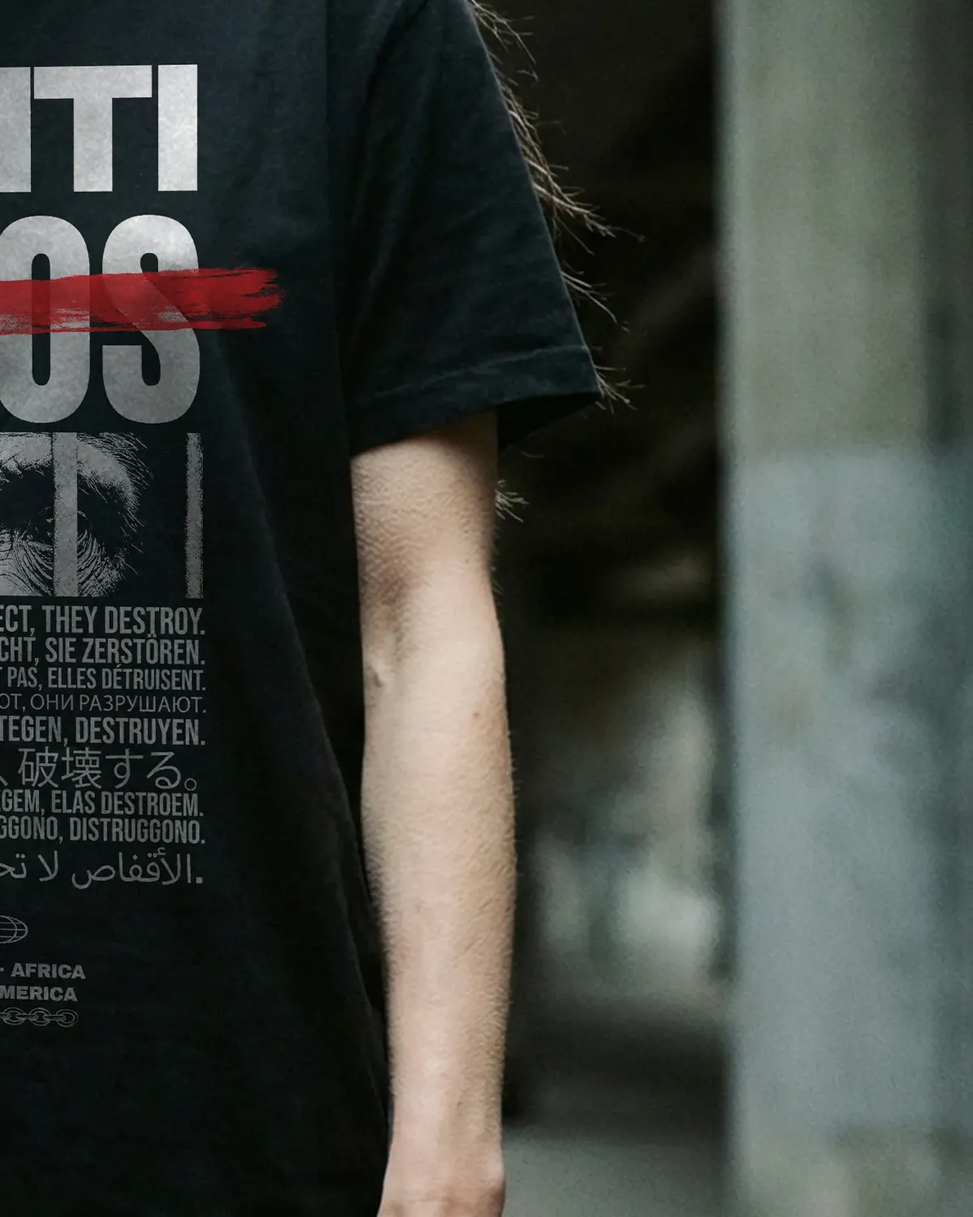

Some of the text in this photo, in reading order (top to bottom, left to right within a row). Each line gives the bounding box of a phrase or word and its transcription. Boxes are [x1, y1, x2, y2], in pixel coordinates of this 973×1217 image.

[42, 605, 98, 634] THEY
[105, 606, 206, 635] DESTROY.
[45, 637, 76, 663] SIE
[82, 633, 206, 665] ZERSTÖREN.
[7, 667, 43, 690] PAS,
[48, 667, 97, 689] ELLES
[101, 663, 206, 691] DÉTRUISENT.
[30, 694, 74, 711] ОНИ
[79, 694, 207, 714] РАЗРУШАЮТ.
[75, 717, 206, 746] DESTRUYEN.
[51, 790, 96, 814] ELAS
[101, 791, 204, 817] DESTROEM.
[69, 817, 206, 845] DISTRUGGONO.
[38, 850, 59, 882] لا
[10, 963, 86, 980] AFRICA
